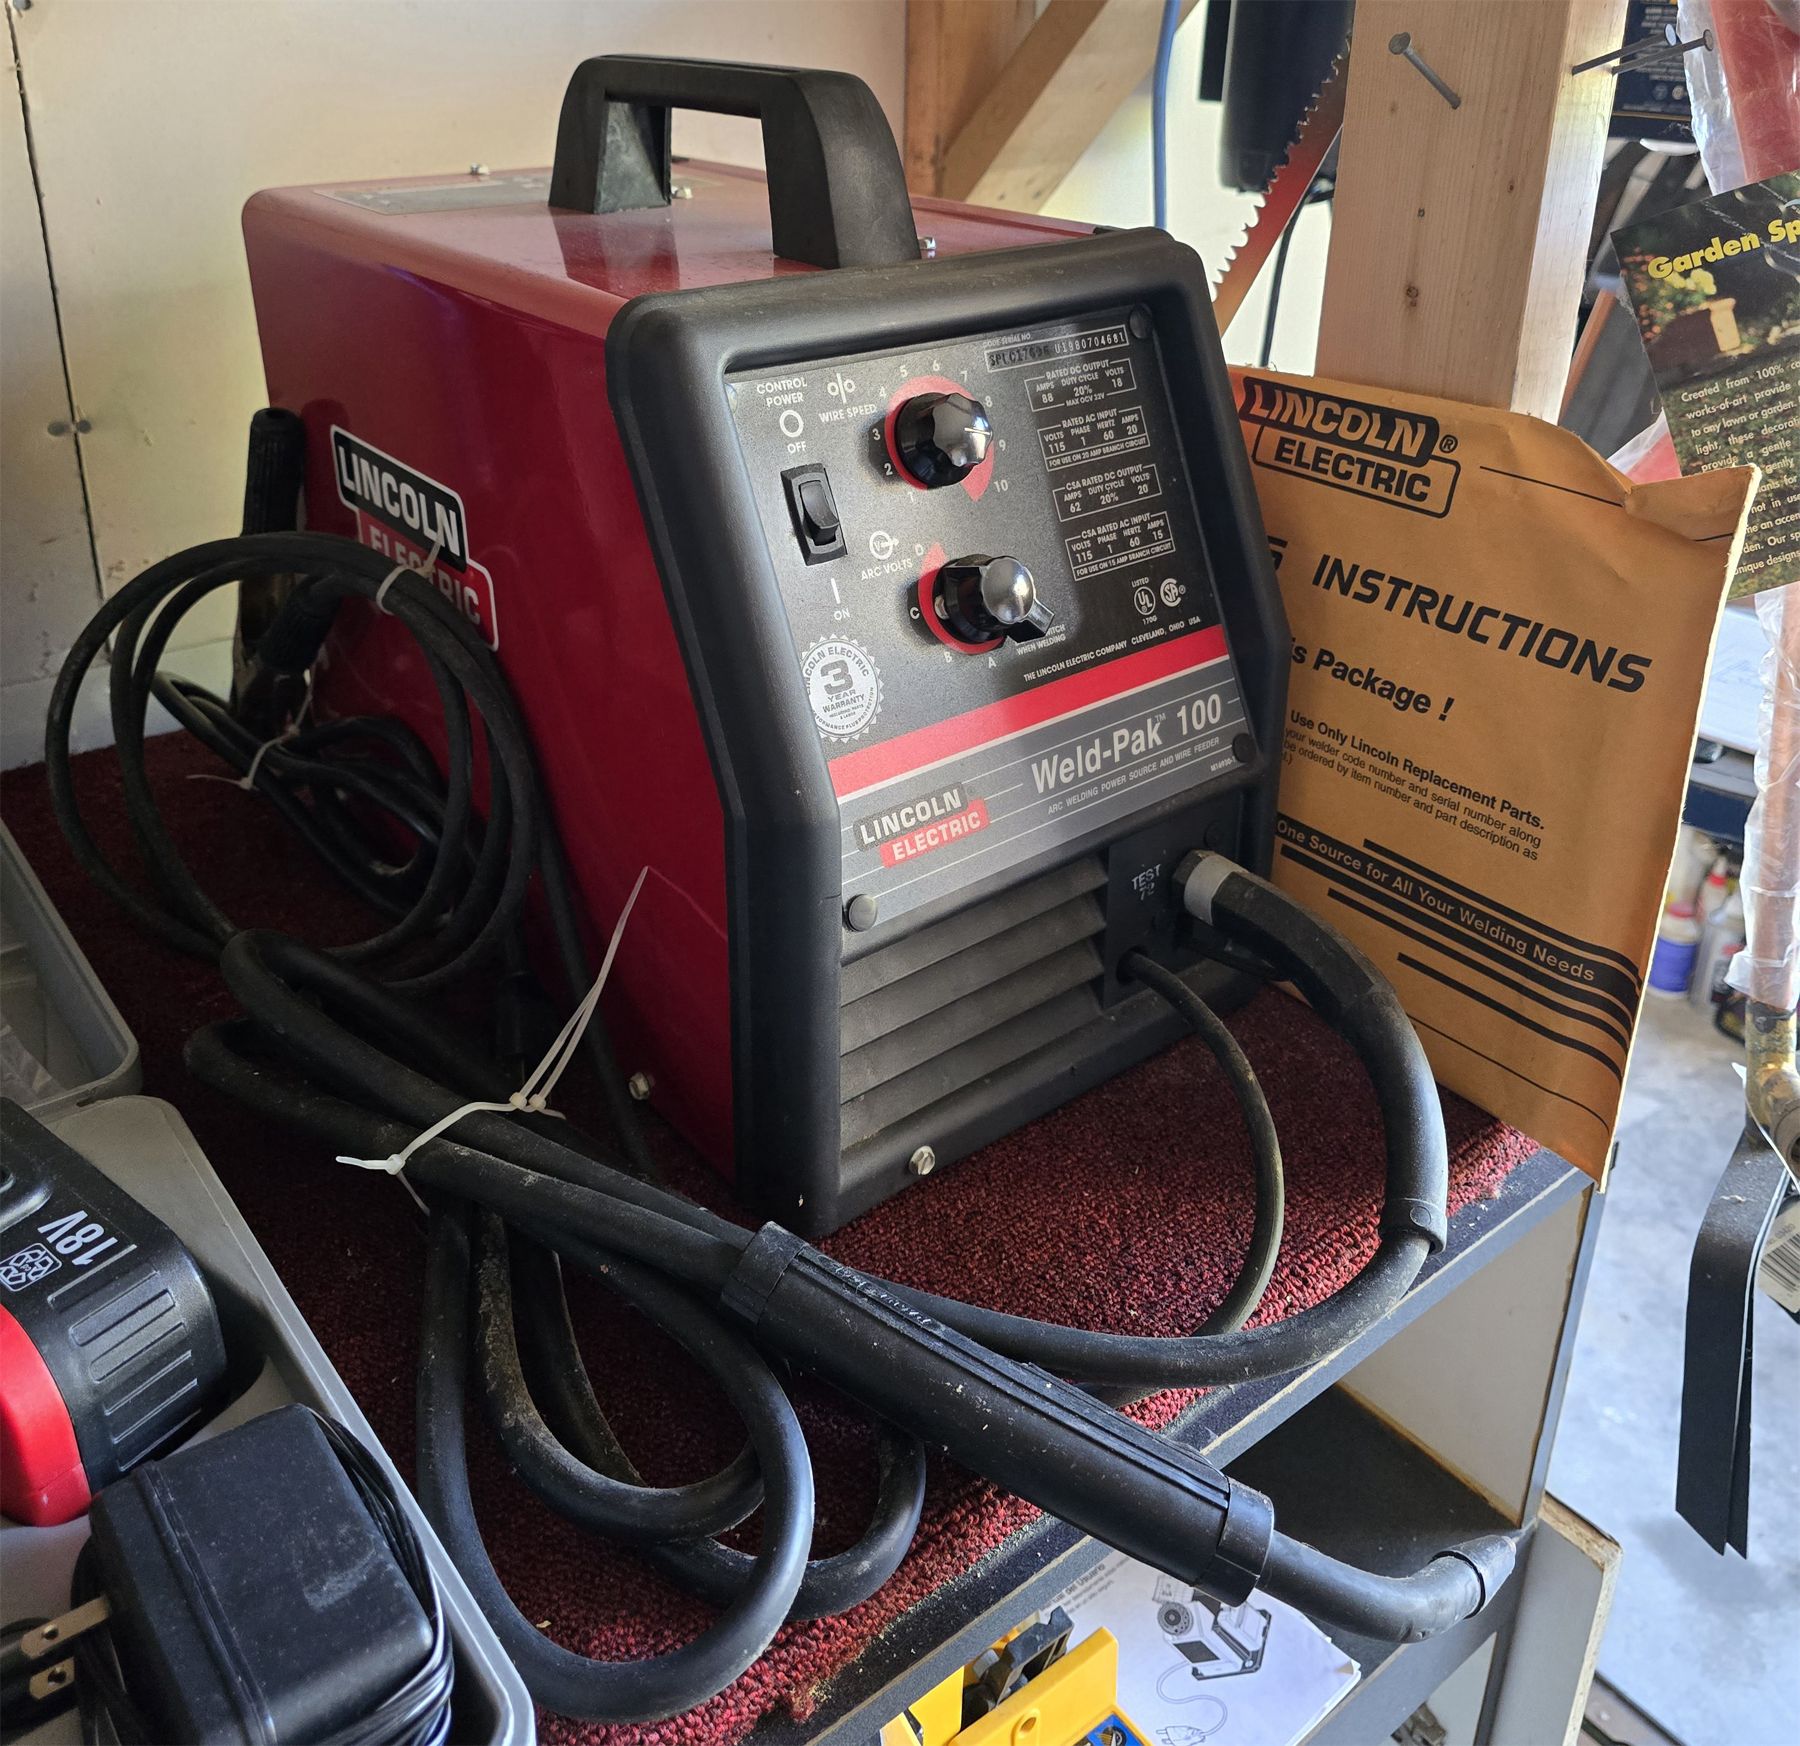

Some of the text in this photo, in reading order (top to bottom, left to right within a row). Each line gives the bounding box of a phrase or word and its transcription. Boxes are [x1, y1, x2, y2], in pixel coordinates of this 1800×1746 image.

[1648, 232, 1761, 279] Garden
[899, 365, 908, 378] 5
[932, 360, 940, 372] 6
[960, 370, 968, 383] 7
[1045, 359, 1110, 380] RATED DC OUTPUT
[756, 377, 808, 394] CONTROL
[879, 386, 887, 399] 4
[1036, 366, 1125, 393] AMPS DUTY CYCLE VOLTS
[1041, 377, 1123, 404] 88 20% 18
[1681, 363, 1785, 402] Created from 100%
[766, 392, 804, 408] POWER
[985, 395, 993, 408] 8
[1686, 381, 1792, 419] works-of-art provide
[818, 404, 877, 423] WIRE SPEED
[1061, 408, 1118, 428] RATED AC INPUT
[1249, 384, 1426, 458] LINCOLN
[1691, 400, 1797, 438] to any lawn or garden.
[872, 428, 881, 441] 3
[1043, 413, 1139, 442] VOLTS PHASE HERTZ AMPS
[1048, 424, 1138, 455] 115 1 60 20
[787, 441, 807, 454] OFF
[999, 439, 1007, 451] 9
[1695, 432, 1755, 456] light, these
[1746, 451, 1754, 460] a
[1762, 438, 1792, 457] gentle
[884, 463, 893, 476] 2
[1065, 465, 1143, 491] CSA RATED DC OUTPUT
[1274, 436, 1431, 502] ELECTRIC
[1765, 456, 1794, 474] gently
[993, 479, 1009, 493] 10
[1063, 473, 1151, 502] AMPS DUTY CYCLE VOLTS
[1783, 474, 1798, 486] for
[338, 446, 461, 557] LINCOLN
[908, 491, 915, 503] 1
[1069, 484, 1149, 513] 62 20% 20
[1751, 498, 1782, 514] not in
[1071, 519, 1165, 552] VOLTS PHASE HERTZ AMPS
[1081, 513, 1151, 539] CSA RATED AC INPUT
[1760, 520, 1774, 531] an
[914, 543, 925, 556] D
[1076, 530, 1164, 563] 115 1 60 15
[1767, 533, 1787, 547] Our
[861, 558, 913, 581] ARC VOLTS
[1076, 544, 1172, 576] FOR USE BRANCH CIRCUIT
[833, 608, 851, 622] ON
[909, 606, 921, 620] C
[1312, 554, 1653, 693] INSTRUCTIONS
[943, 651, 954, 664] B
[1016, 633, 1067, 656] WHEN WELDING
[1023, 616, 1201, 682] THE LINCOLN ELECTRIC COMPANY CLEVELAND, OHIO USA
[827, 646, 870, 677] ELECTRIC
[988, 656, 998, 669] A
[820, 659, 854, 695] 3
[1312, 648, 1431, 713] Package
[822, 694, 865, 713] WARRANTY
[827, 689, 856, 703] YEAR
[1176, 693, 1222, 736] 100
[1048, 737, 1220, 815] ARC WELDING POWER SOURCE AND WIRE FEEDER
[1290, 710, 1545, 830] Use Only Lincoln Replacement Parts.
[1298, 747, 1335, 769] ordered
[1336, 761, 1349, 777] by
[1351, 768, 1372, 786] item
[1374, 780, 1412, 804] number
[1413, 799, 1434, 815] and
[1435, 809, 1458, 826] part
[1460, 819, 1520, 853] description
[1522, 847, 1539, 861] as
[1308, 738, 1340, 757] welder
[1342, 752, 1366, 769] code
[1369, 764, 1406, 787] number
[1408, 780, 1428, 797] and
[1431, 792, 1460, 811] serial
[1463, 806, 1506, 831] number
[1508, 826, 1542, 849] along
[860, 789, 962, 845] LINCOLN
[891, 811, 981, 861] ELECTRIC
[1131, 864, 1162, 890] TEST
[1277, 819, 1595, 981] One Source for All Your Welding Needs
[37, 1210, 118, 1266] 18V
